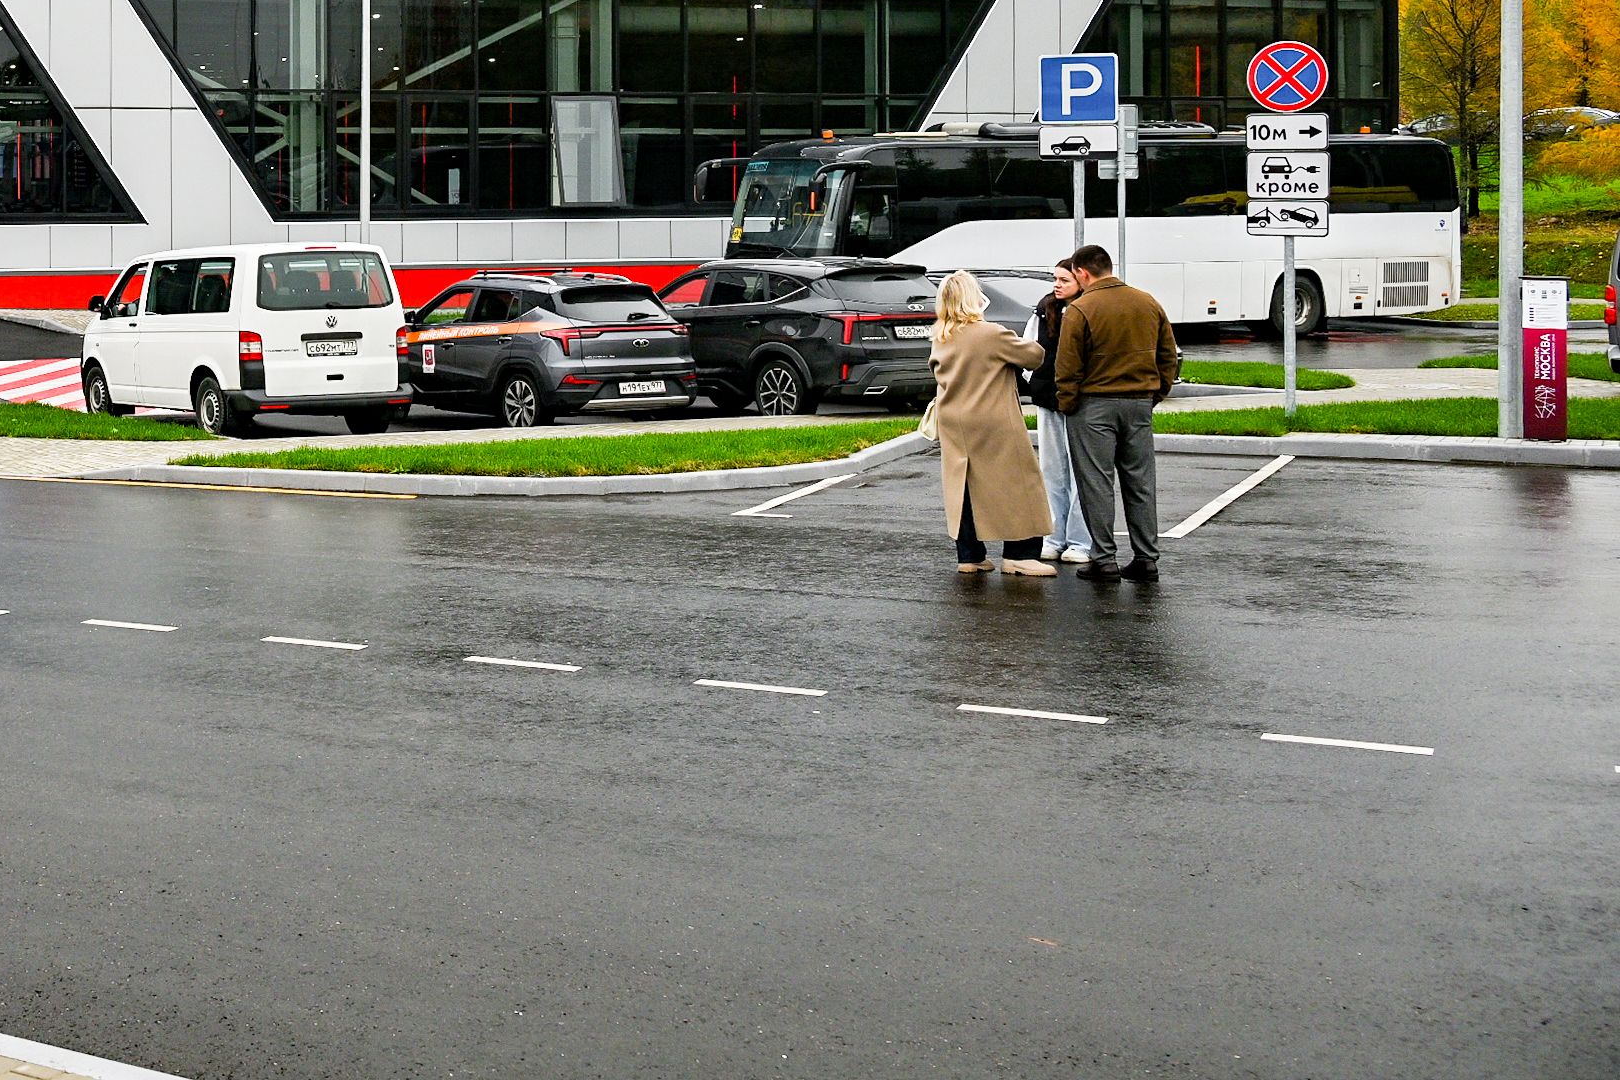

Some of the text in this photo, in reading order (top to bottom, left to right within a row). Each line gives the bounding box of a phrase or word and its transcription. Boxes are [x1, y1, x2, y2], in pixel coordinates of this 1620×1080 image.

[1061, 63, 1103, 115] P
[1256, 182, 1319, 196] кроме
[1540, 333, 1551, 380] МОСКВА
